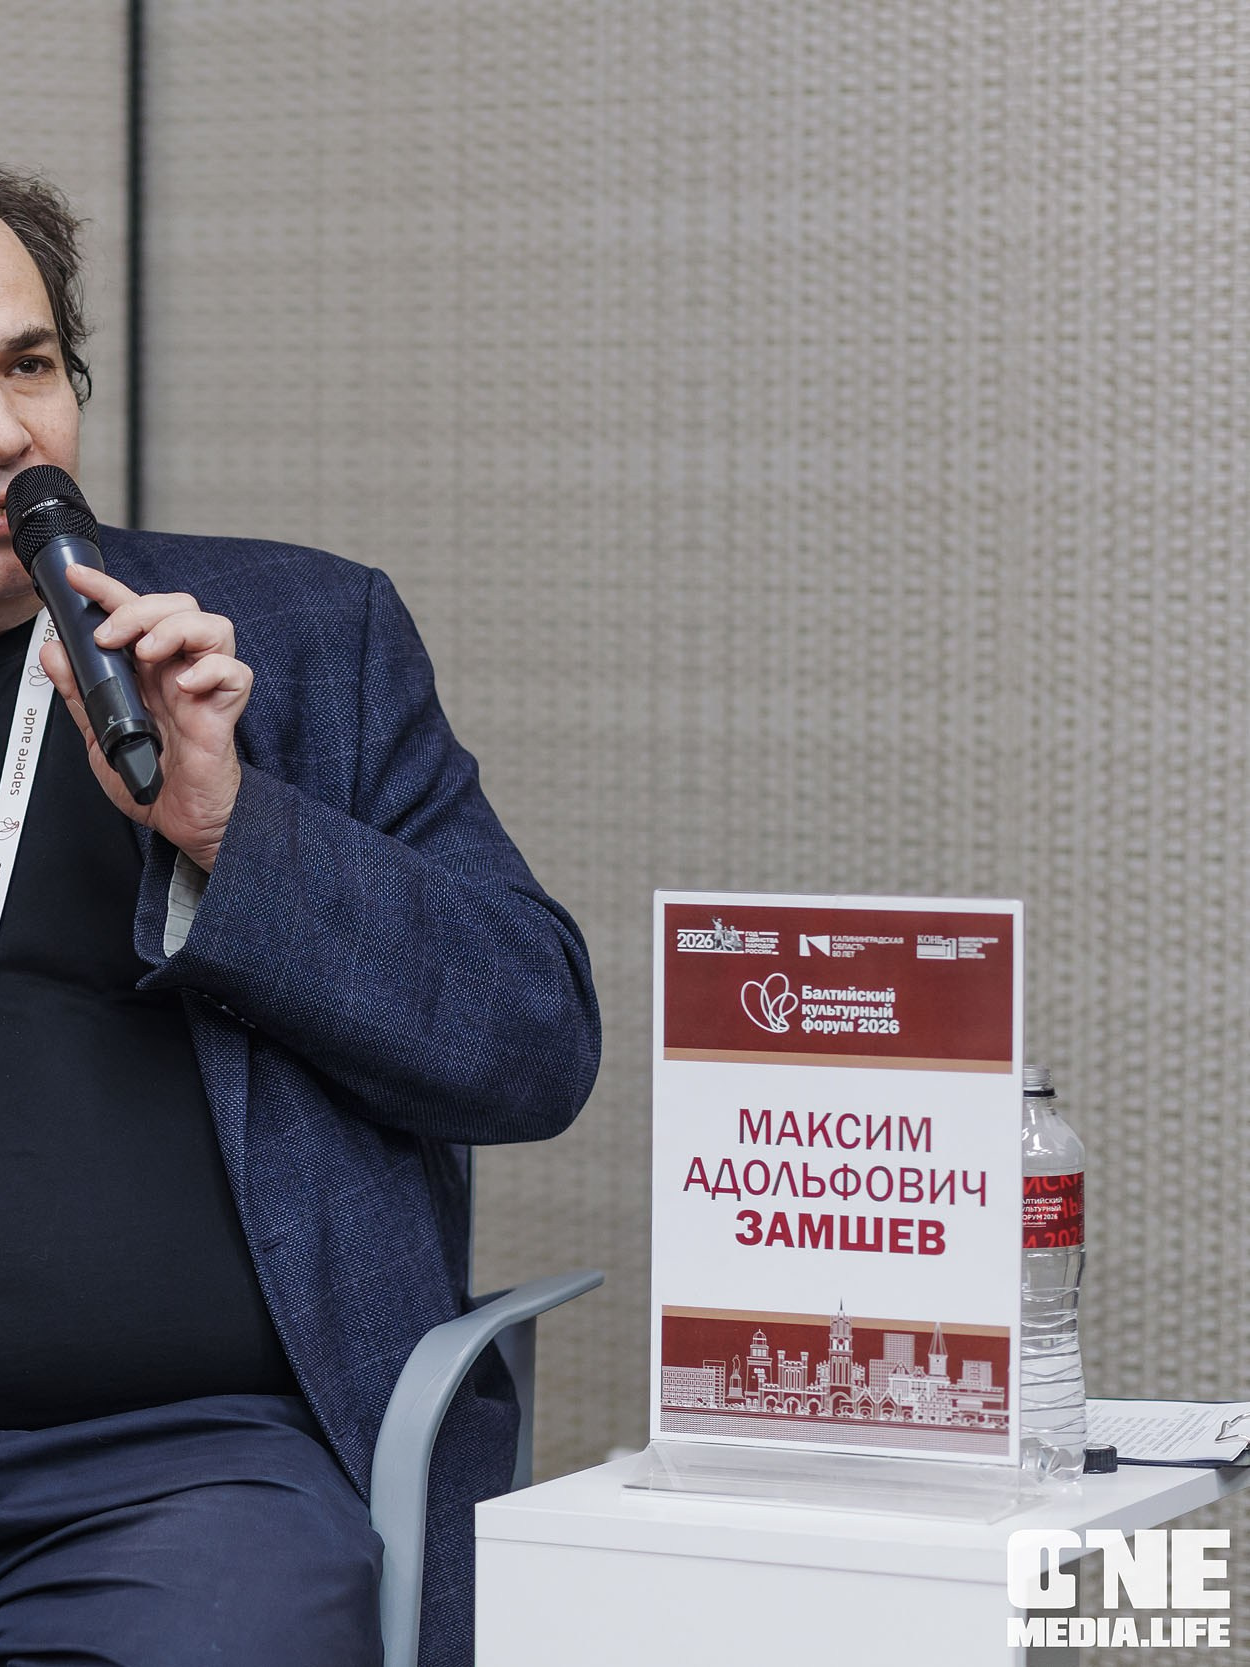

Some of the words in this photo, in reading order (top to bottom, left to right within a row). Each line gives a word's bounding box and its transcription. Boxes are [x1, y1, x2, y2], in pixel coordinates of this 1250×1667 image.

[10, 748, 29, 796] sapere
[21, 707, 38, 744] aude
[677, 933, 714, 949] 2026
[801, 984, 896, 1003] Балтийский
[801, 1002, 894, 1020] культурный
[801, 1016, 855, 1035] форум
[857, 1018, 900, 1034] 2026
[738, 1108, 932, 1153] МАКСИМ
[682, 1156, 987, 1207] АДОЛЬФОВИЧ
[1022, 1196, 1063, 1205] АЛТИЙСКИЙ
[1022, 1204, 1062, 1213] УЛЬТУРНЫЙ
[1022, 1213, 1043, 1221] ОРУМ
[735, 1209, 947, 1256] ЗАМШЕВ
